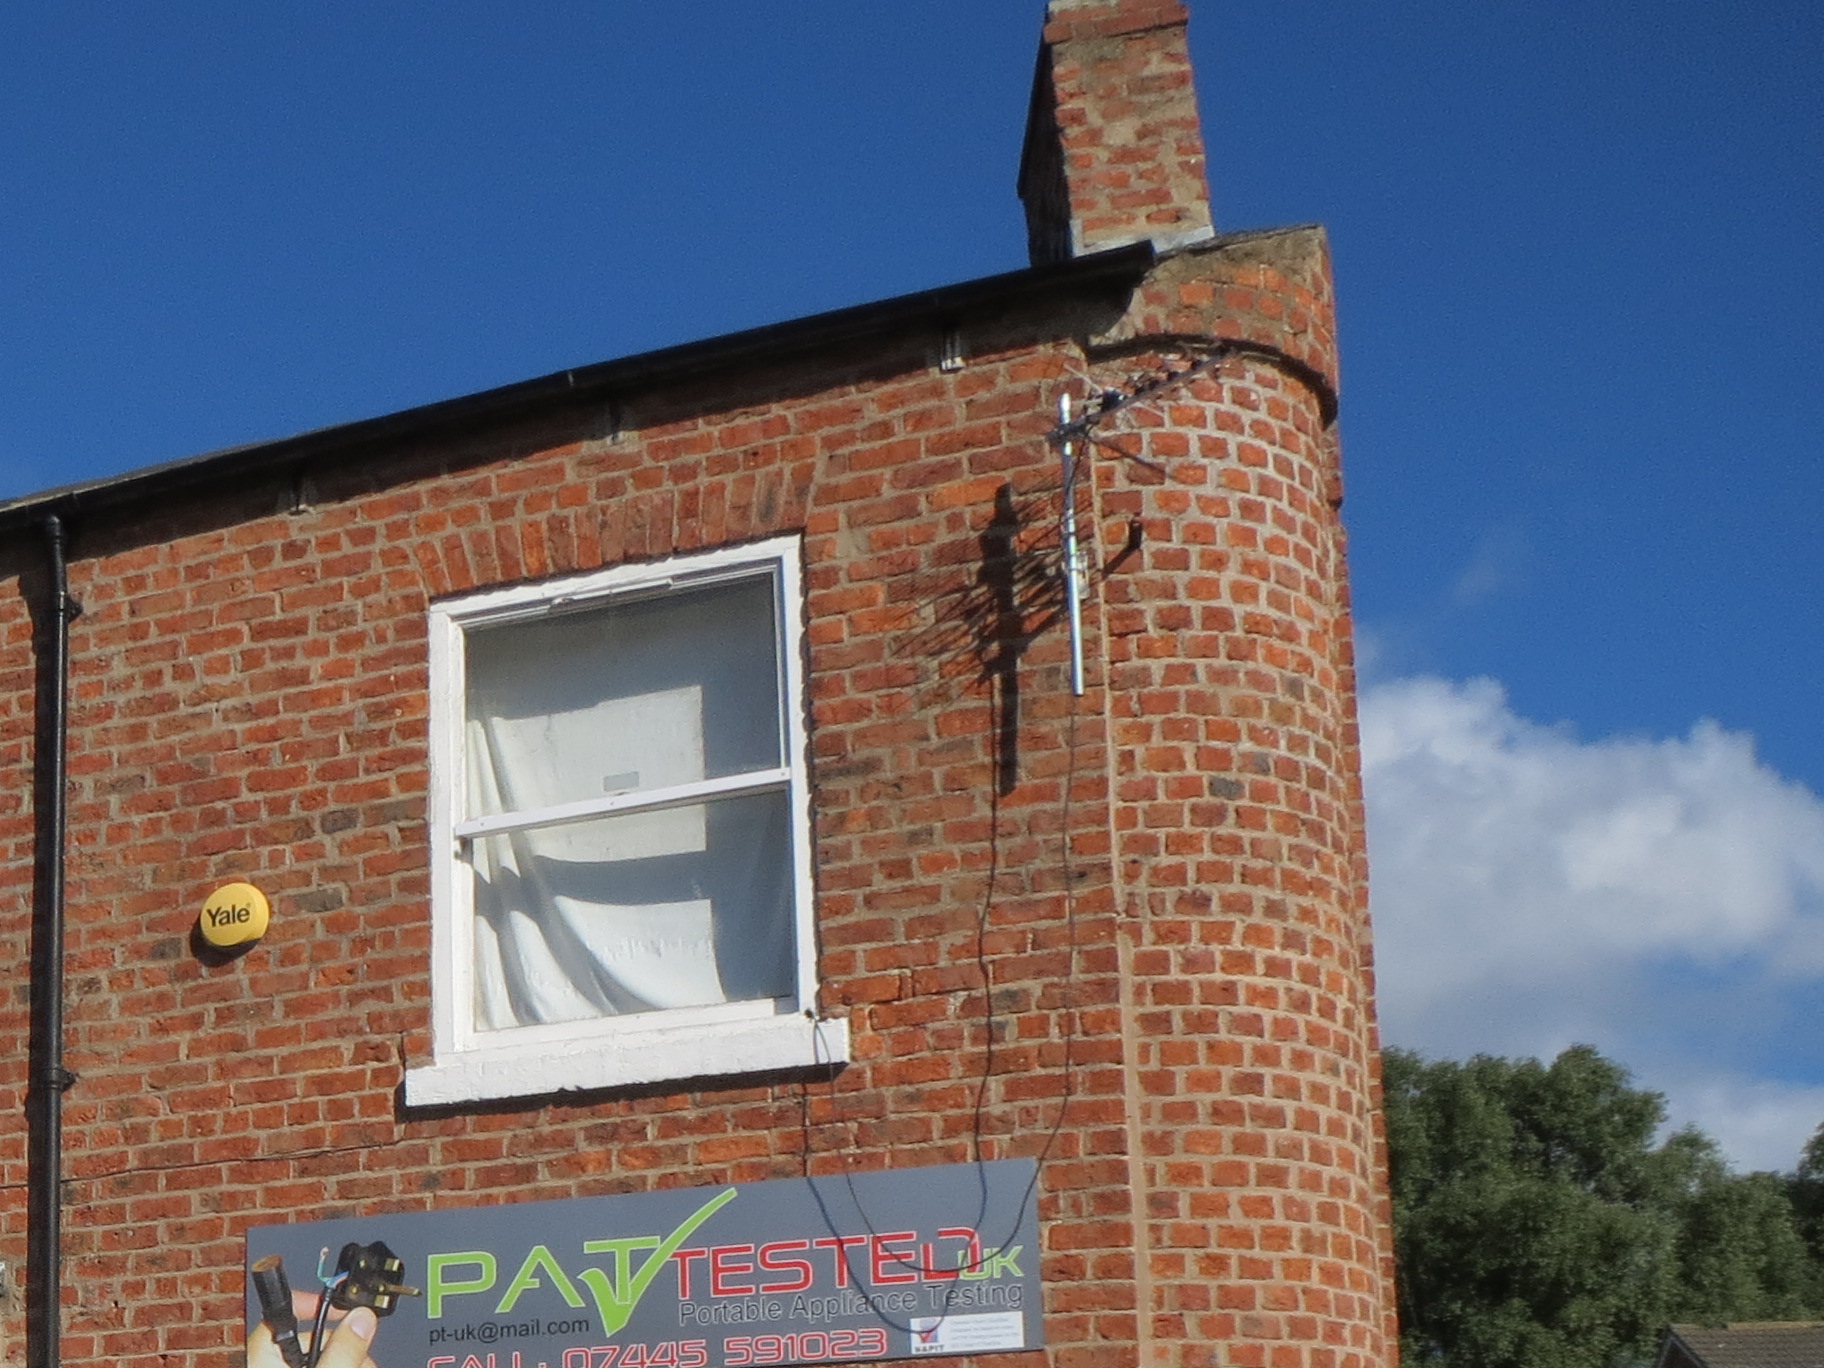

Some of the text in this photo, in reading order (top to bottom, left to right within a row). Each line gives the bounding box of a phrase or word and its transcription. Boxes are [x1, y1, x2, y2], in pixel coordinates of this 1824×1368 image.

[207, 905, 250, 927] Yale
[670, 1227, 981, 1299] TESTED
[680, 1283, 1023, 1326] Portable Appliance Testing
[428, 1318, 590, 1347] pt-uk@mail.com
[723, 1328, 889, 1366] 591023
